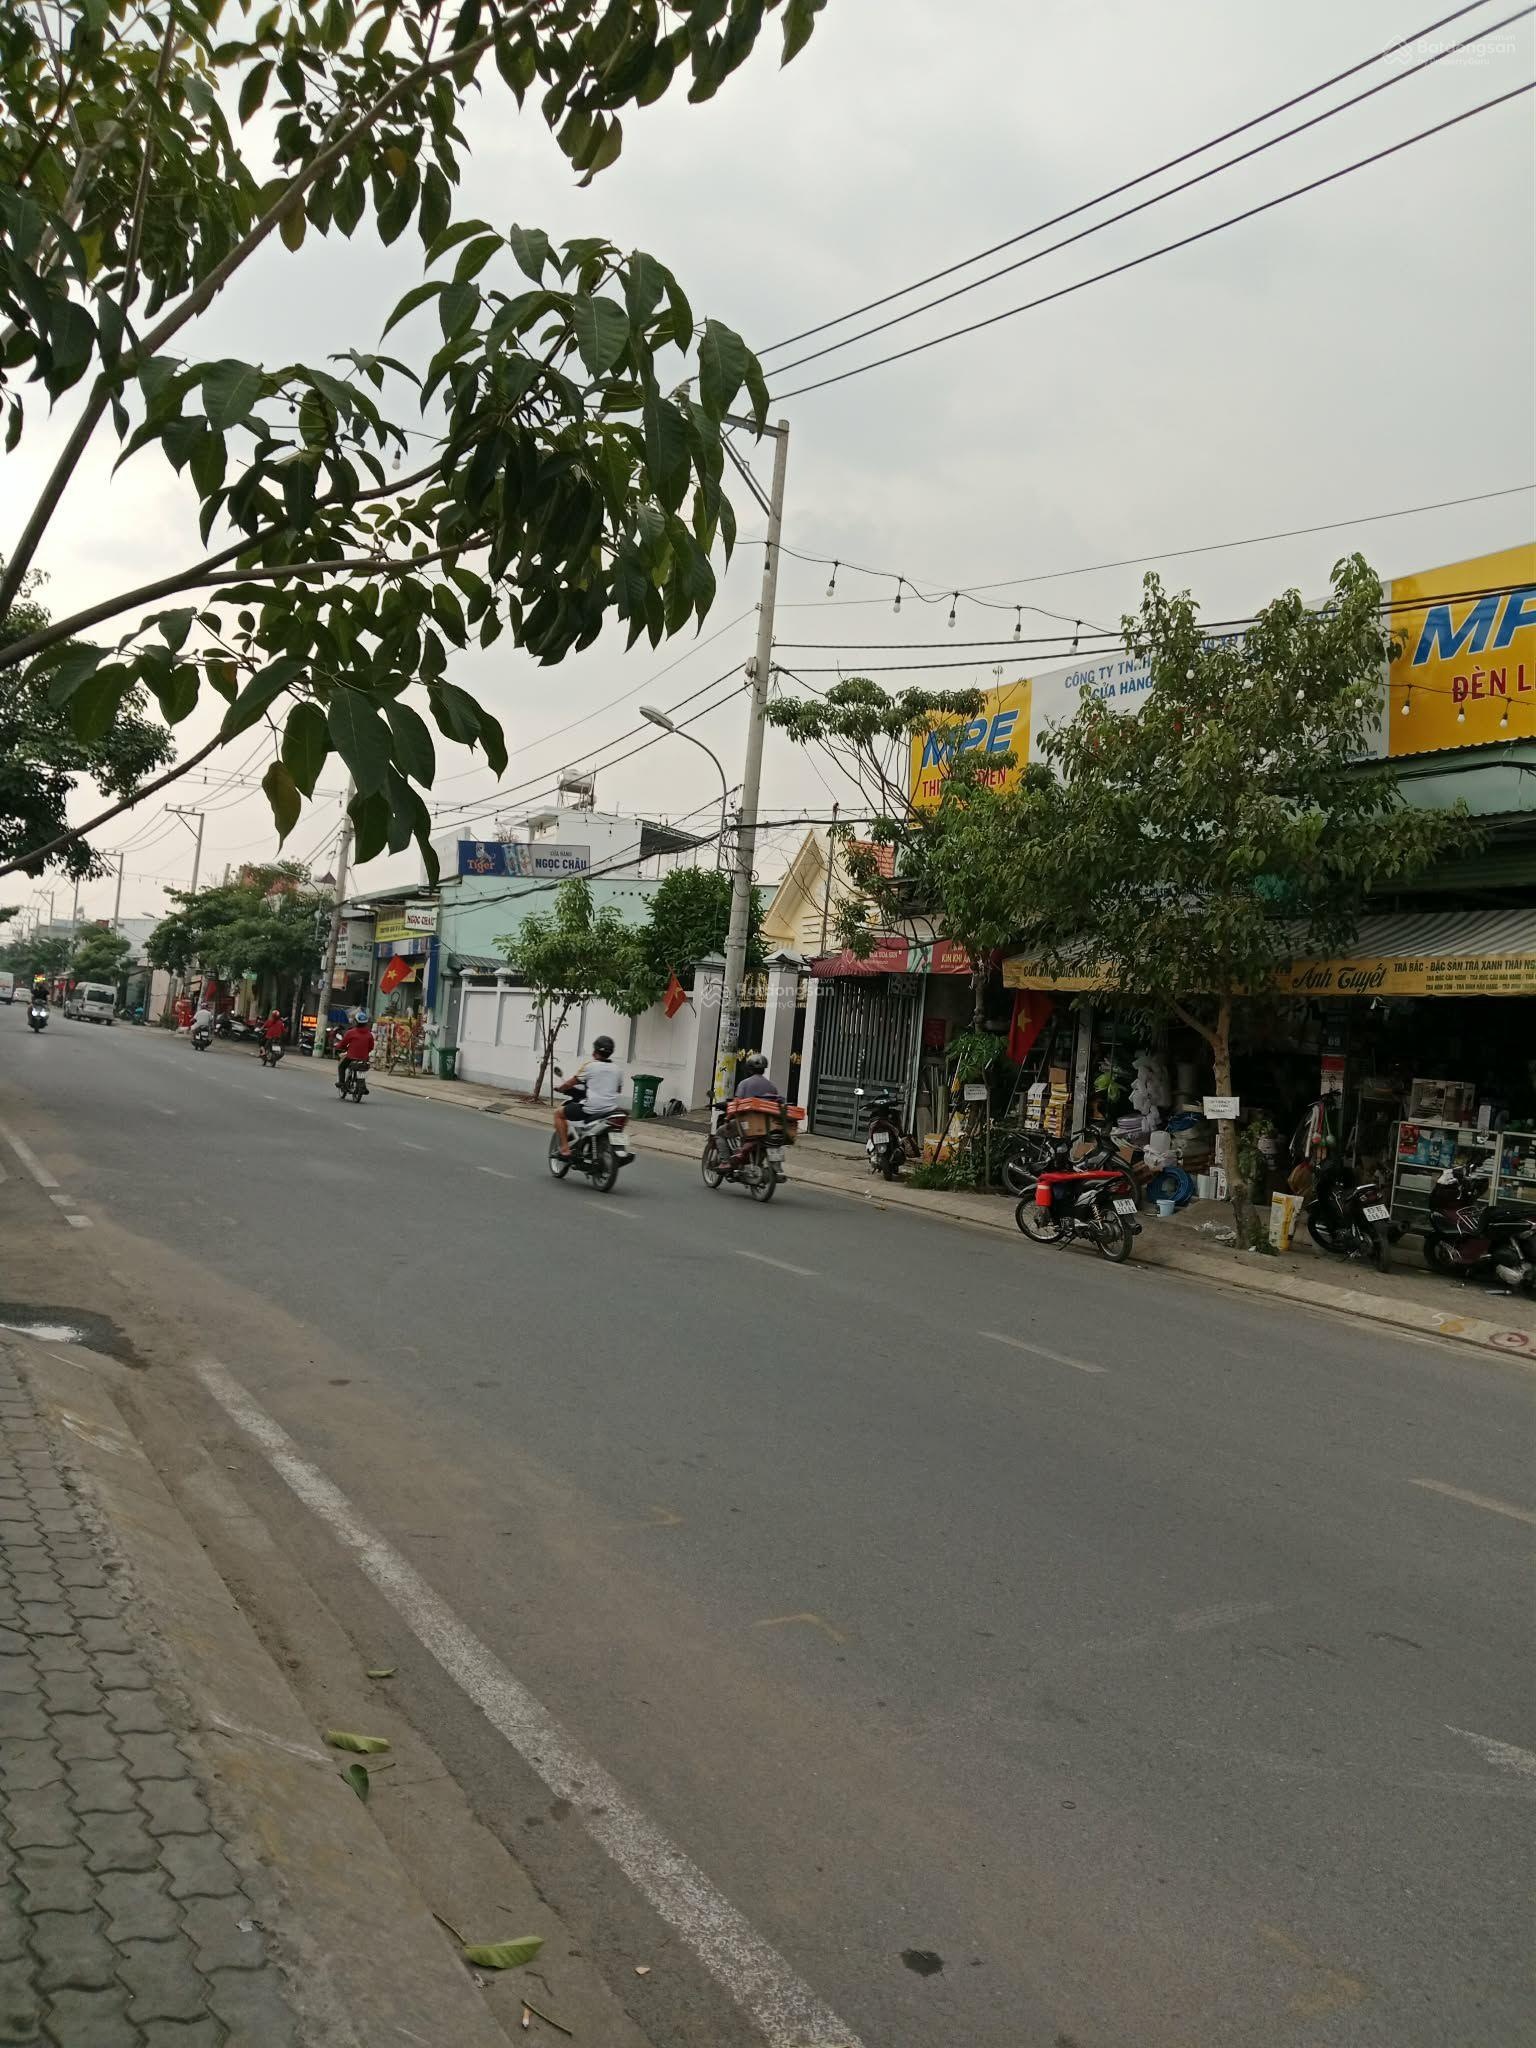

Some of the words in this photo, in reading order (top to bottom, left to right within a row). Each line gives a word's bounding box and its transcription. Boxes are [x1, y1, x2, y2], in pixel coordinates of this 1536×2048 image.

[1065, 670, 1095, 689] CÔNG
[1098, 664, 1114, 679] TY
[1119, 675, 1153, 696] HÀNG
[1452, 665, 1507, 704] ĐÈN
[921, 708, 1020, 769] MPE
[466, 859, 496, 874] Tiger
[535, 858, 560, 872] NGỌC
[562, 856, 587, 870] CHÂU
[1480, 960, 1503, 971] XANH
[1292, 962, 1332, 989] Ánh
[1337, 962, 1388, 994] Tuyết
